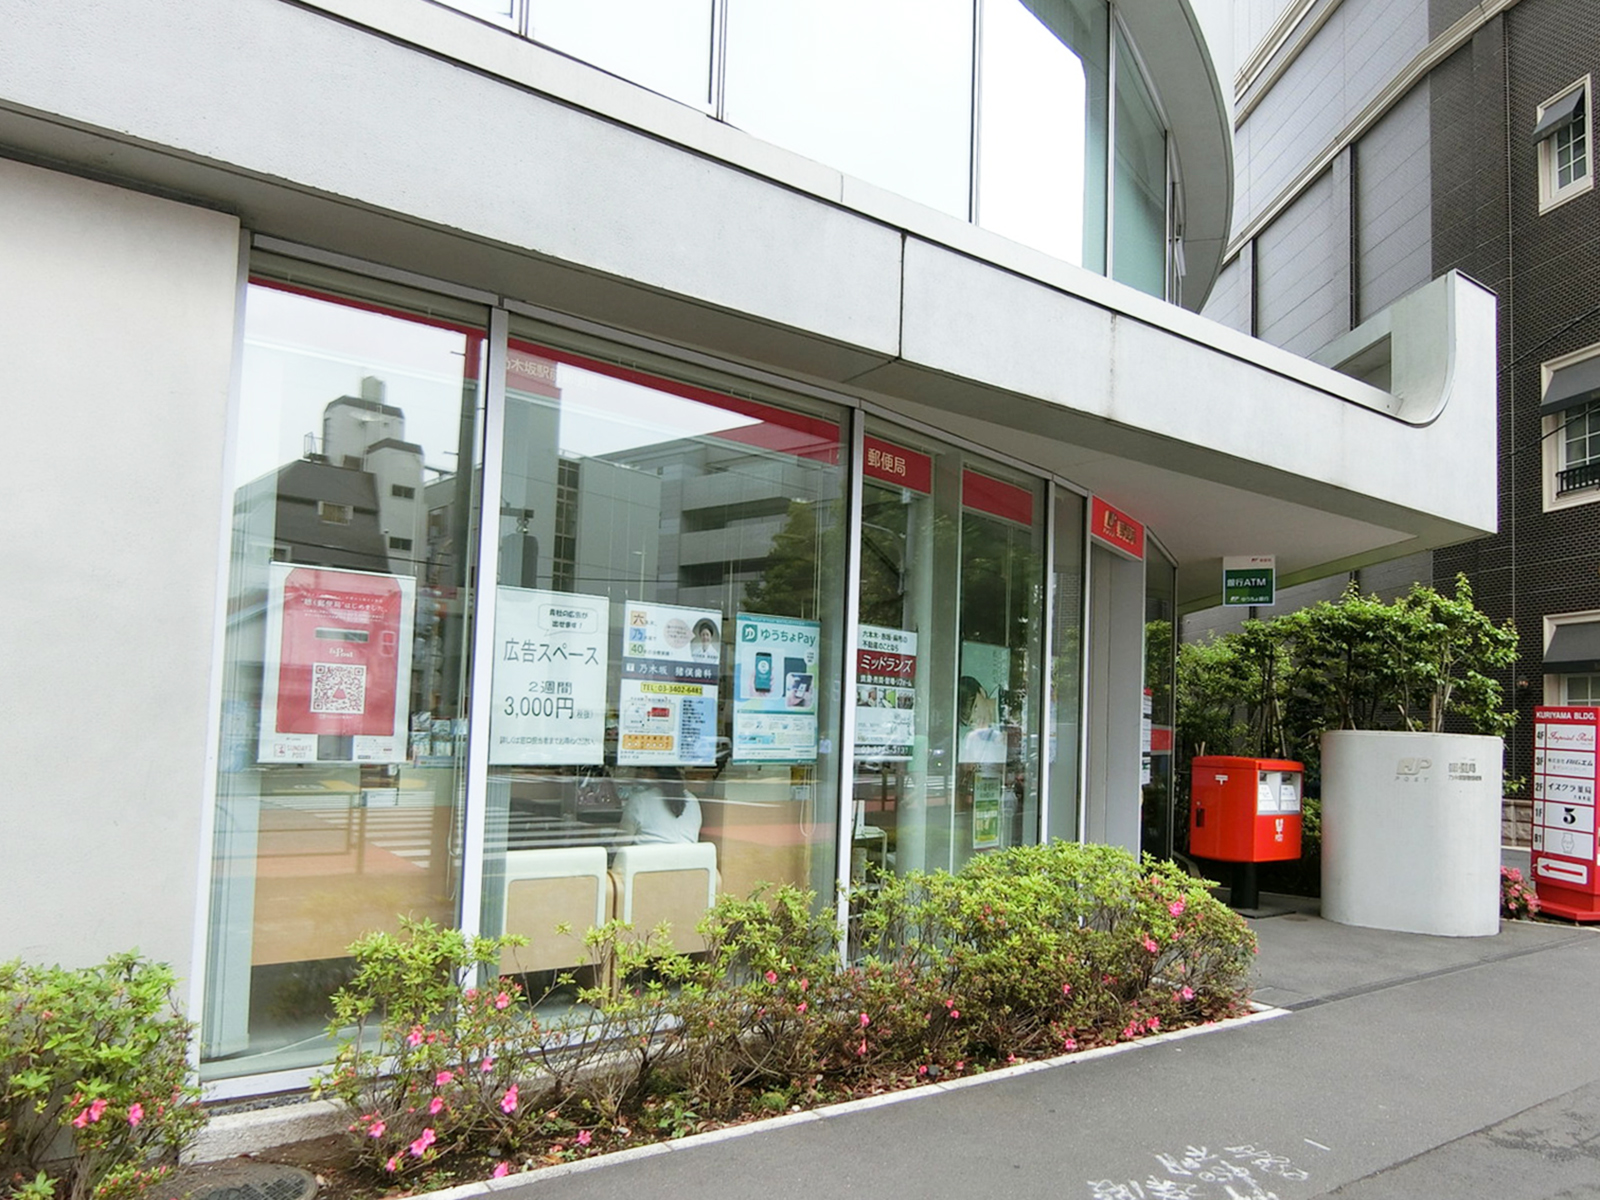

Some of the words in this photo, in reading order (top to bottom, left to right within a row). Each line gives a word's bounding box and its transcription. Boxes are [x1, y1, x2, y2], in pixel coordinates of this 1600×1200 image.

[867, 448, 907, 477] 郵便局
[1226, 577, 1267, 588] 銀行ATM
[761, 628, 816, 647] ゆうちょPay
[503, 637, 599, 666] 広告スペース
[860, 654, 914, 673] ミッドランズ
[528, 681, 573, 696] 2週間
[504, 695, 574, 720] 3,000円
[1536, 712, 1572, 721] KURIYAMA
[1574, 712, 1597, 722] BLDG.
[1535, 782, 1543, 792] 2F
